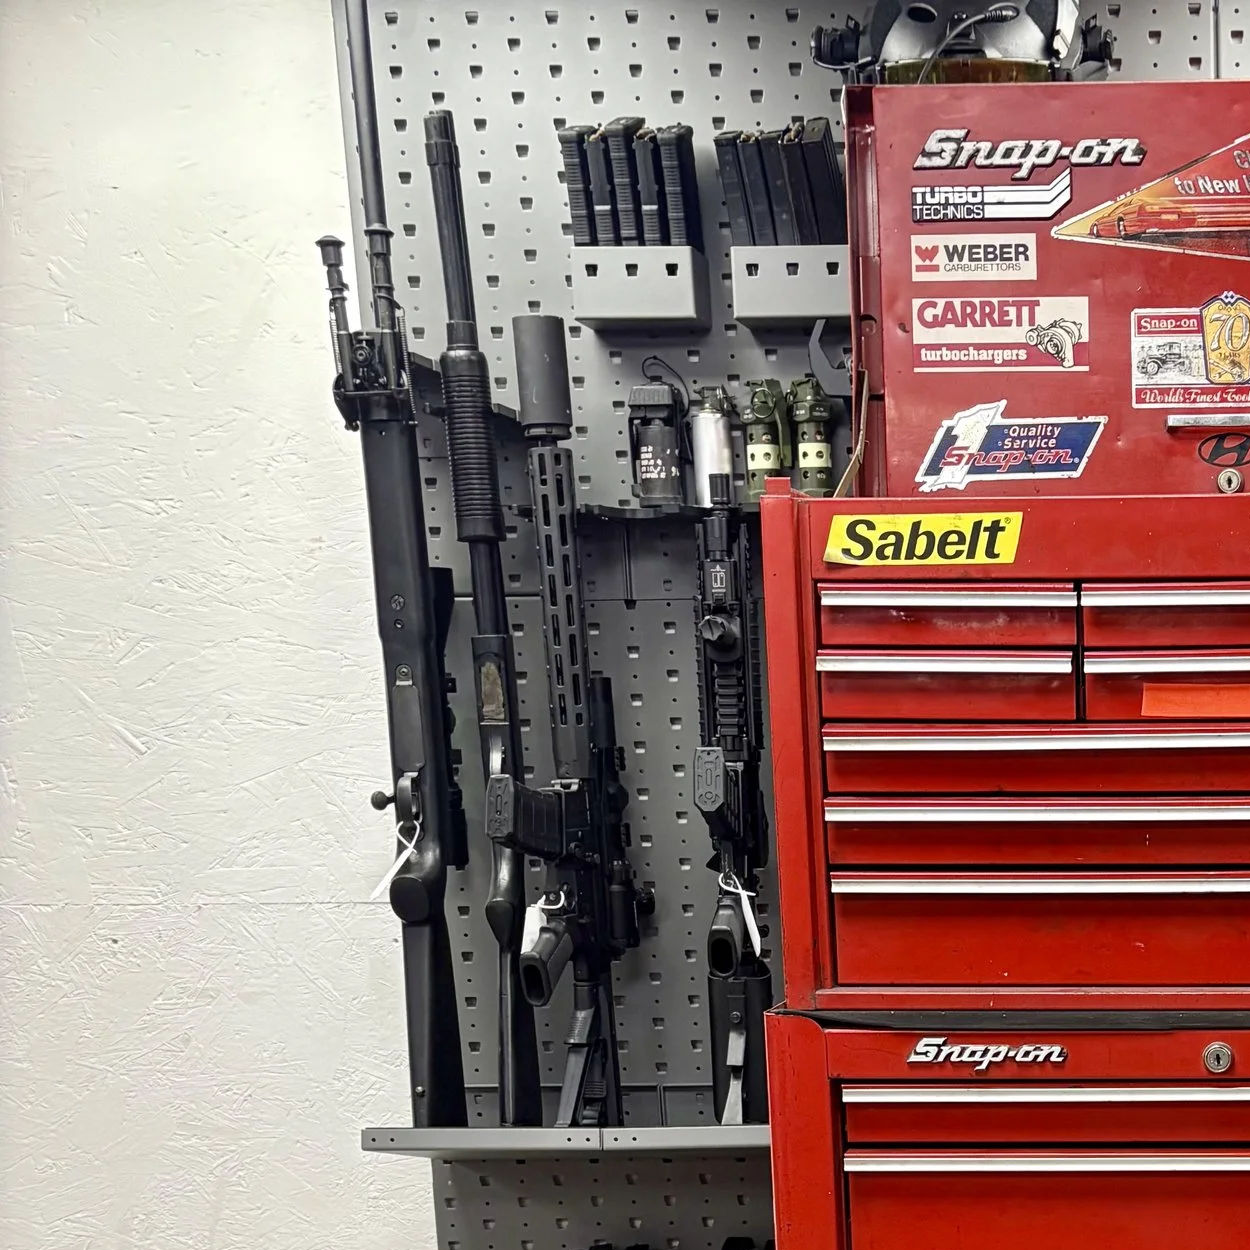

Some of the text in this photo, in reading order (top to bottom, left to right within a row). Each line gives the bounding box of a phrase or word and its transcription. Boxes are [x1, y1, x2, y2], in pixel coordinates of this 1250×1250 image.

[913, 129, 1147, 180] Snap-on
[1174, 175, 1194, 194] to
[1197, 176, 1240, 194] New
[912, 187, 984, 203] TURBO
[912, 204, 984, 219] TECHNICS
[943, 244, 1030, 263] WEBER
[943, 263, 1022, 272] CARBURETTORS
[916, 300, 1041, 329] GARRETT
[1140, 317, 1198, 332] Snap-on
[1208, 312, 1250, 352] 70
[920, 346, 1028, 364] turbochargers
[1184, 389, 1222, 403] Finest
[1008, 424, 1061, 439] Quality
[1003, 436, 1057, 448] Service
[939, 446, 1074, 473] Snap-on
[841, 518, 1006, 561] Sabelt
[906, 1036, 1068, 1071] Snap-on
